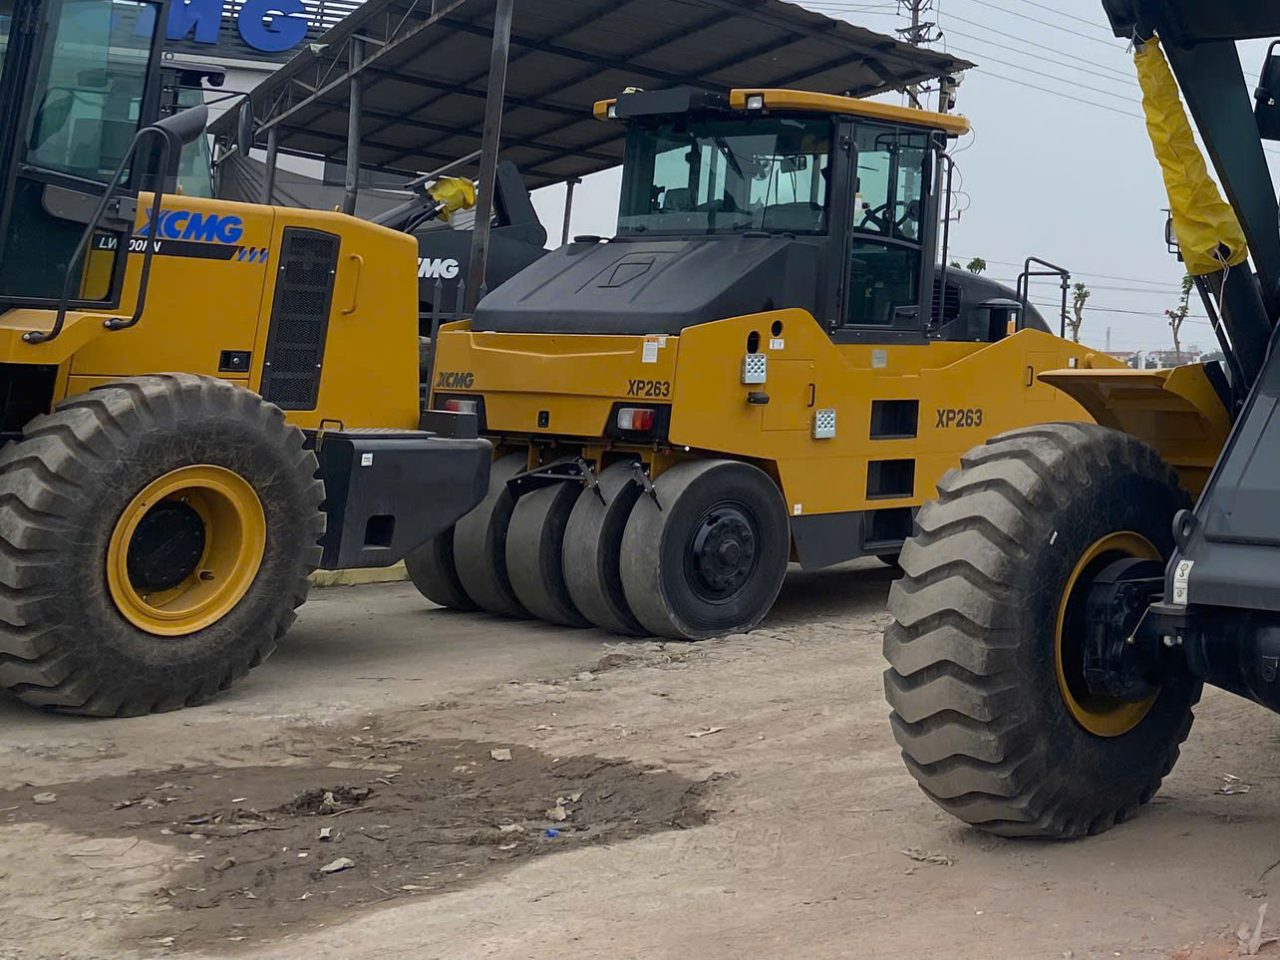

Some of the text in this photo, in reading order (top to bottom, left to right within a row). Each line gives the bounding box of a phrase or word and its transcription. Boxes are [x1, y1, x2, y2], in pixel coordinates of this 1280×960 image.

[418, 257, 460, 279] MG
[436, 372, 475, 389] XCMG
[627, 380, 671, 397] XP263
[936, 408, 983, 428] XP263
